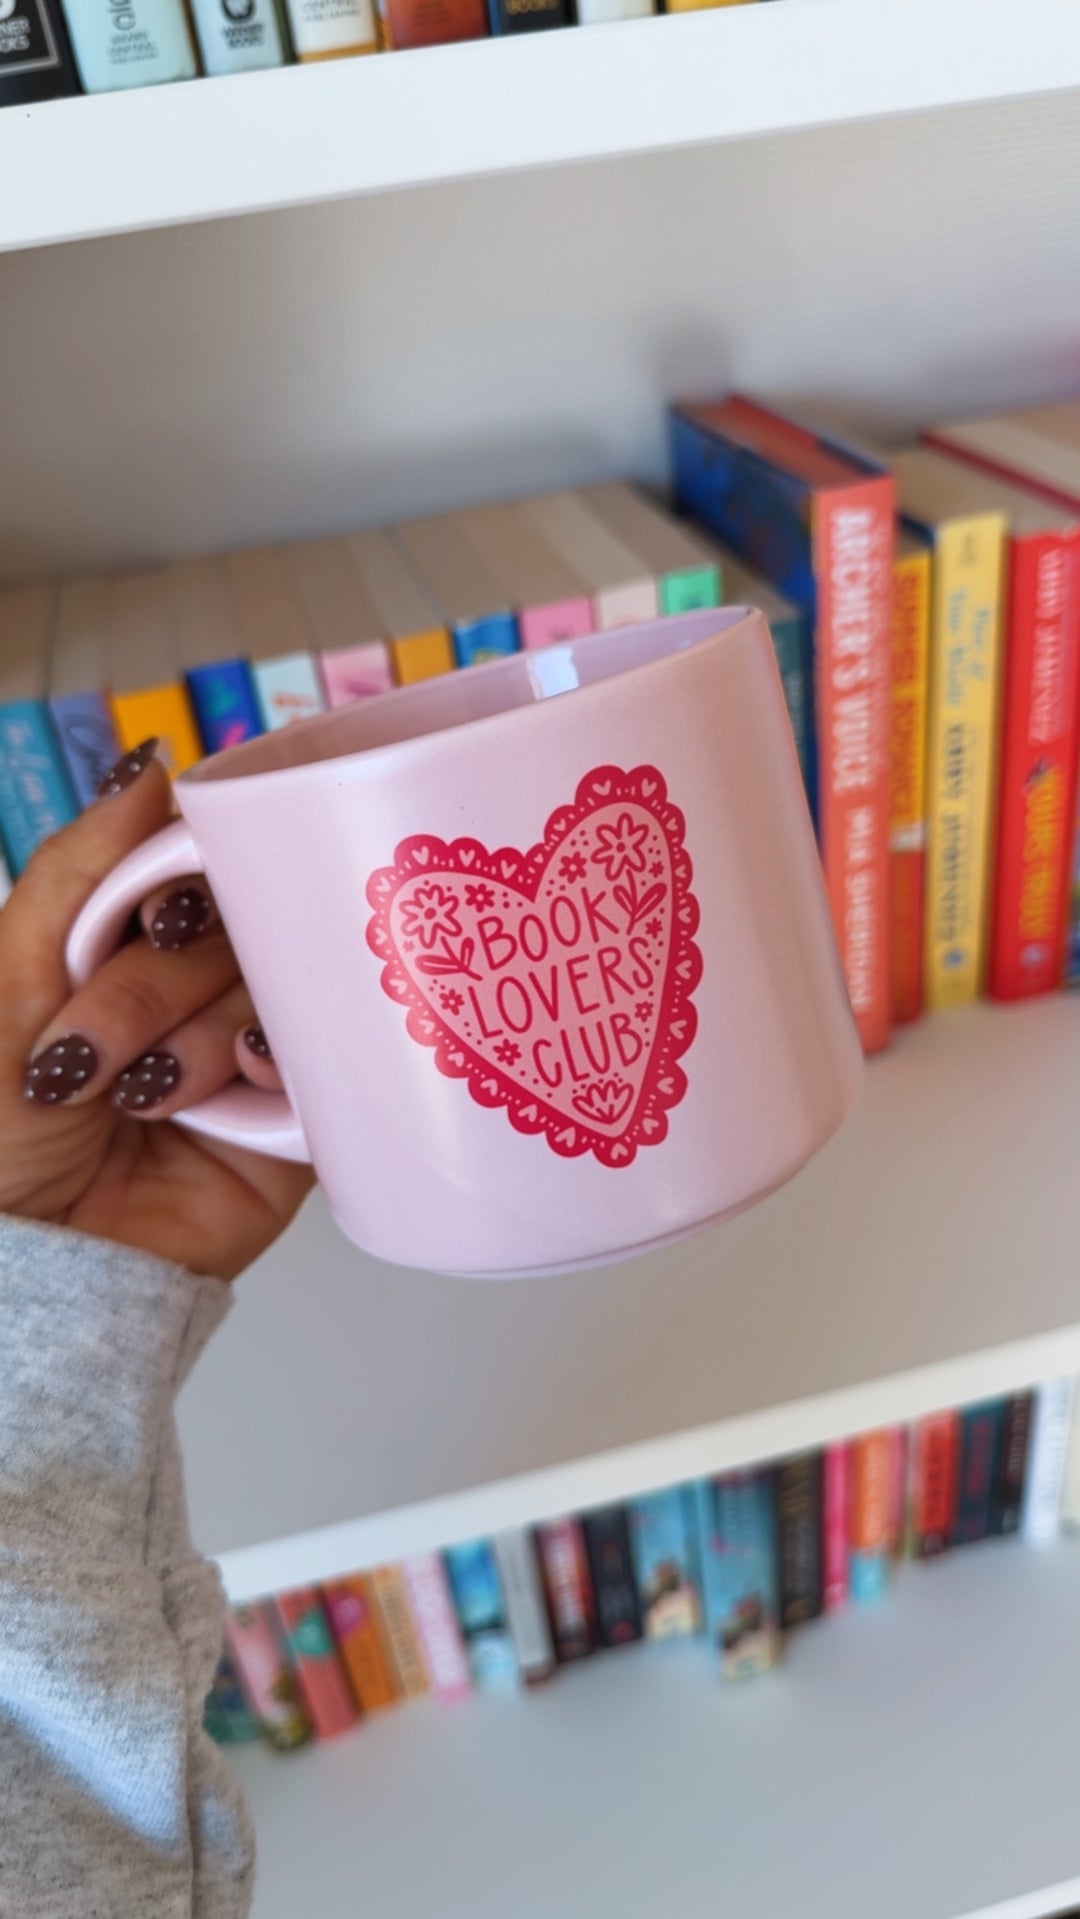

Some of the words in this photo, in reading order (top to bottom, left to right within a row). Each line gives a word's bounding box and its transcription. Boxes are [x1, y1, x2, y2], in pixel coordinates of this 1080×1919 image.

[831, 508, 876, 689] ARCHER'S
[831, 692, 873, 796] VOICE
[477, 886, 620, 970] BOOK
[468, 937, 654, 1038] LOVERS
[532, 1012, 643, 1088] CLUB
